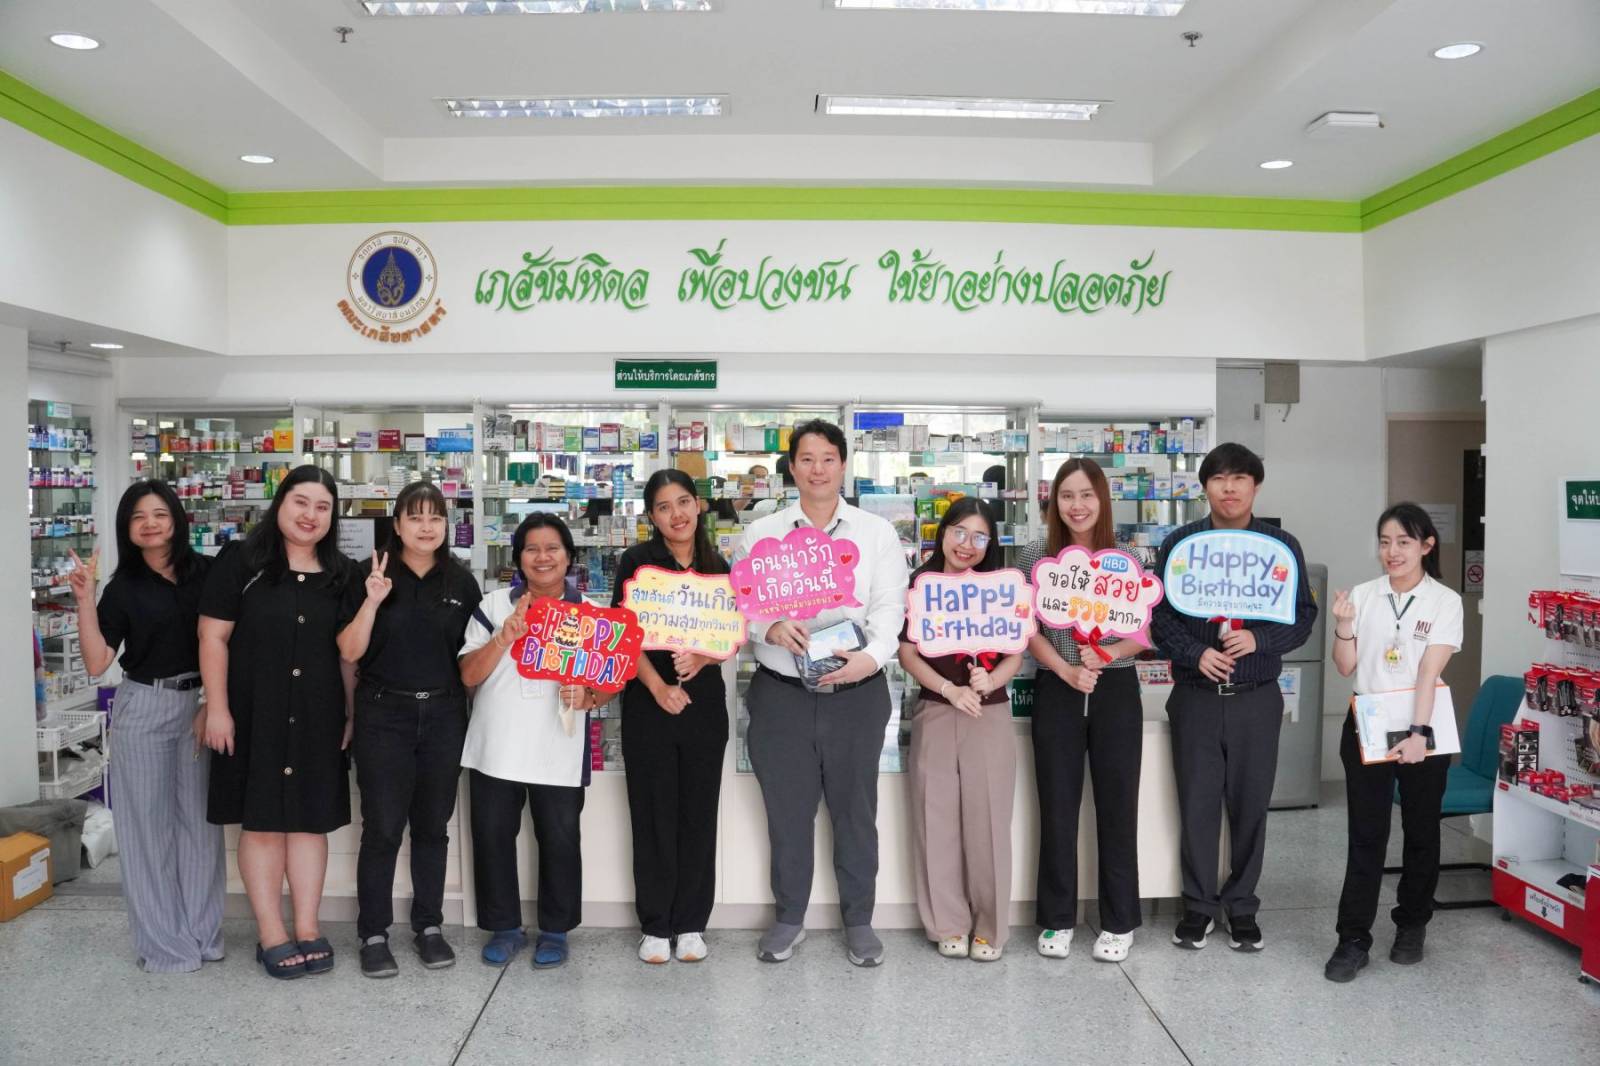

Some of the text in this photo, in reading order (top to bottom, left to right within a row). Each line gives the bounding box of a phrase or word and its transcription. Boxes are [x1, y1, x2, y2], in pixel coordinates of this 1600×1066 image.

[474, 238, 1172, 315] เภสัชมหิดล เพื่อปวงชน ใช้ยาอย่างปลอดภัย
[616, 368, 716, 381] ส่วนให้บริการโดยเภสัชกร
[751, 537, 833, 576] คนน่ารัก
[1103, 557, 1128, 569] HBD
[1188, 543, 1276, 580] Happy
[757, 560, 838, 602] เกิดวันนี้
[1414, 619, 1432, 634] MU
[522, 636, 630, 685] BIRTHDAY
